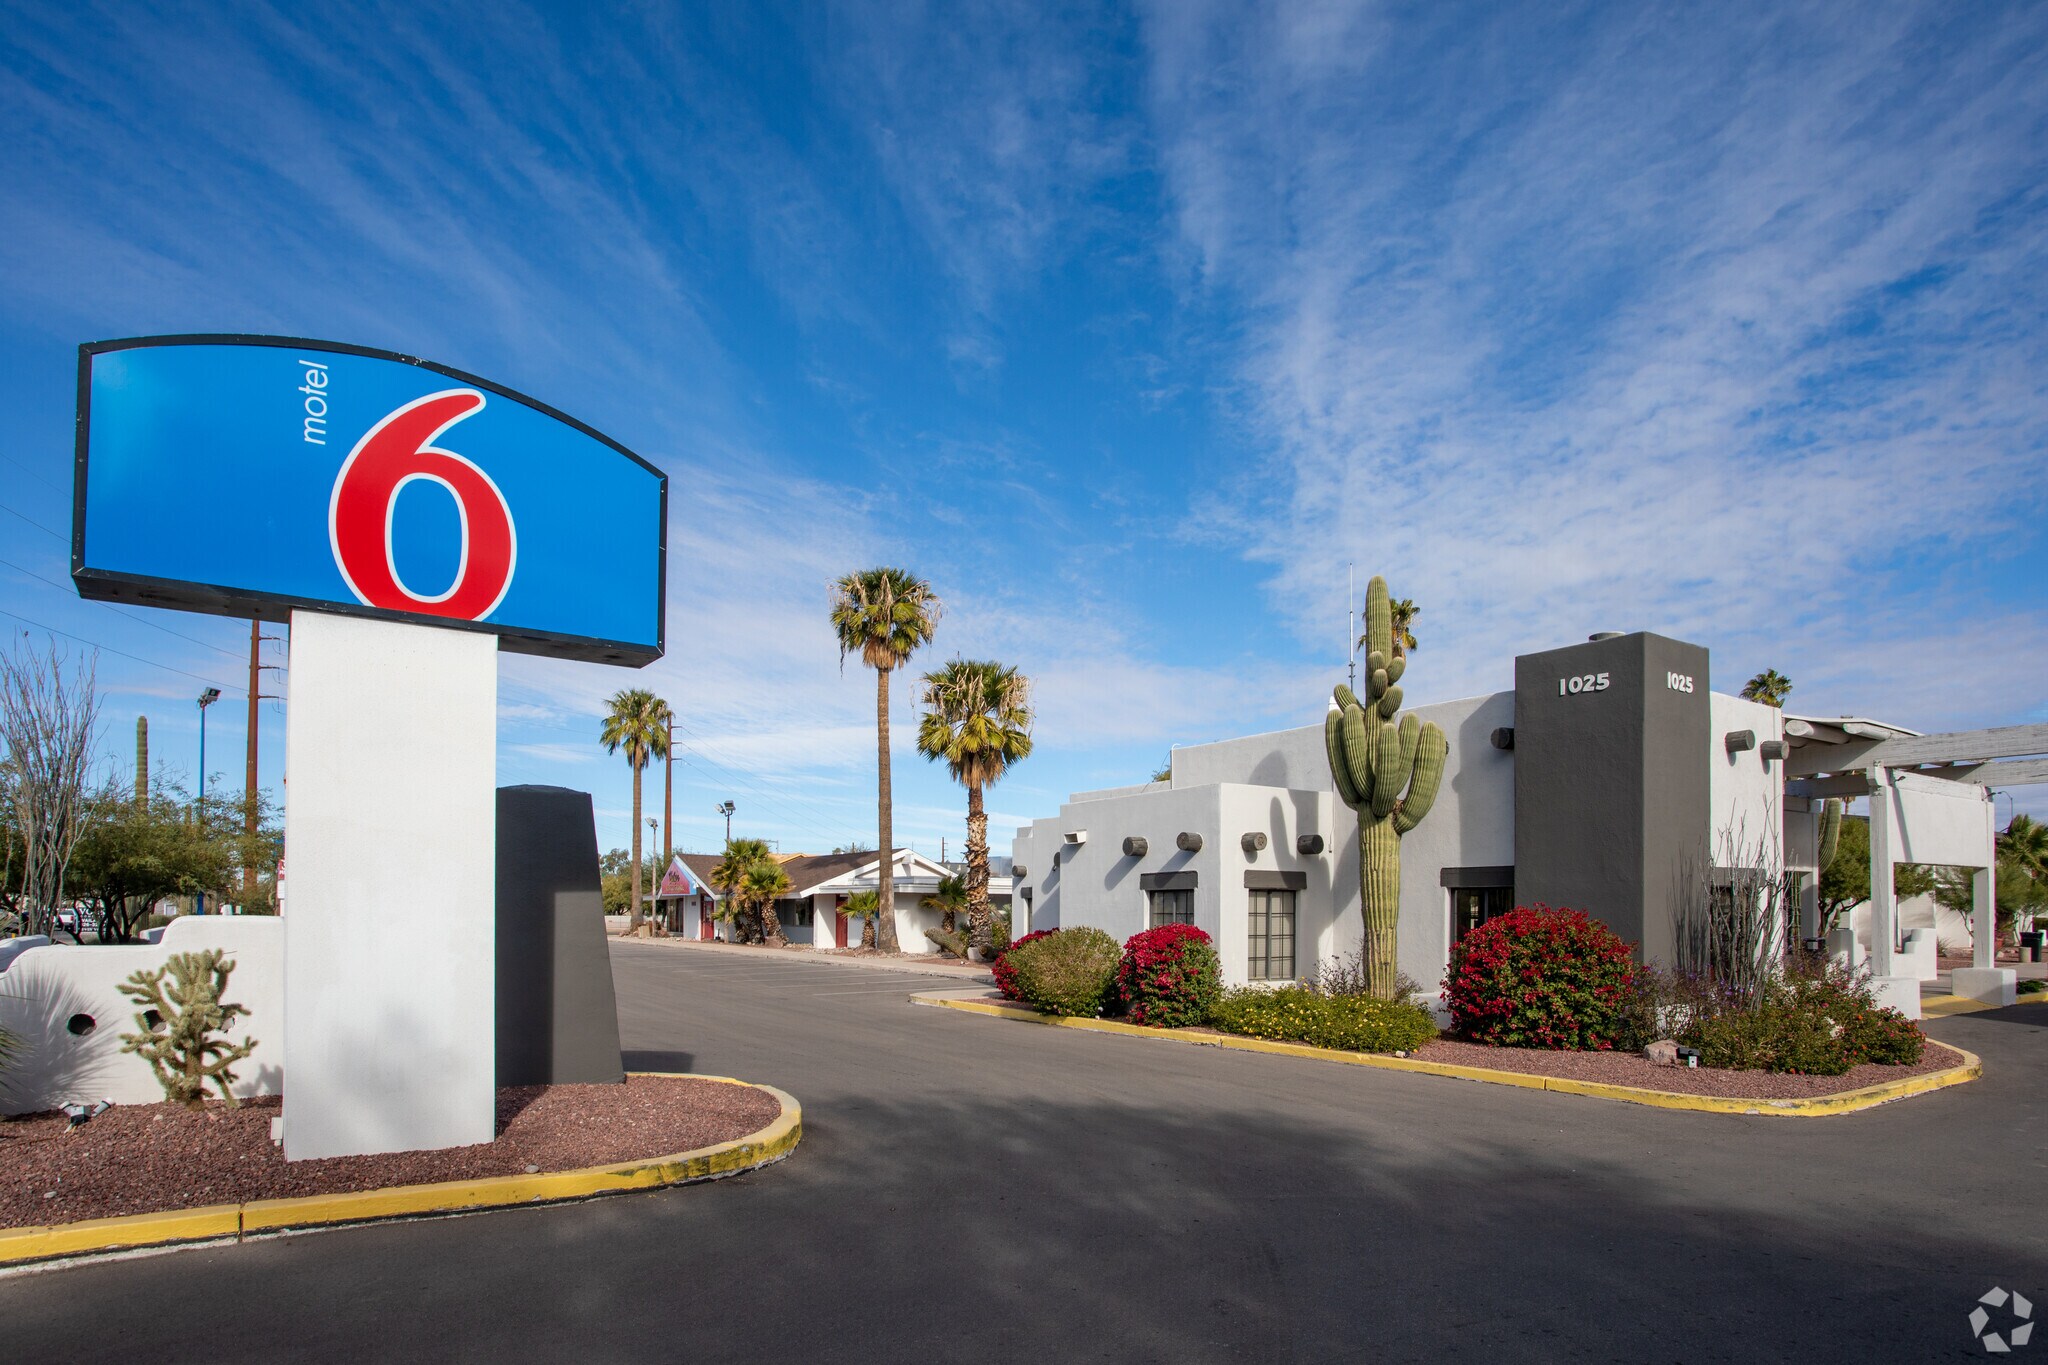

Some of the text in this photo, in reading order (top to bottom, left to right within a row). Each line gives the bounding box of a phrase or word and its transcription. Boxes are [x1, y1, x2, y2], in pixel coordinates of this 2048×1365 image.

[299, 360, 517, 621] motel 6
[1559, 672, 1610, 696] 1025
[1667, 671, 1694, 694] 1025
